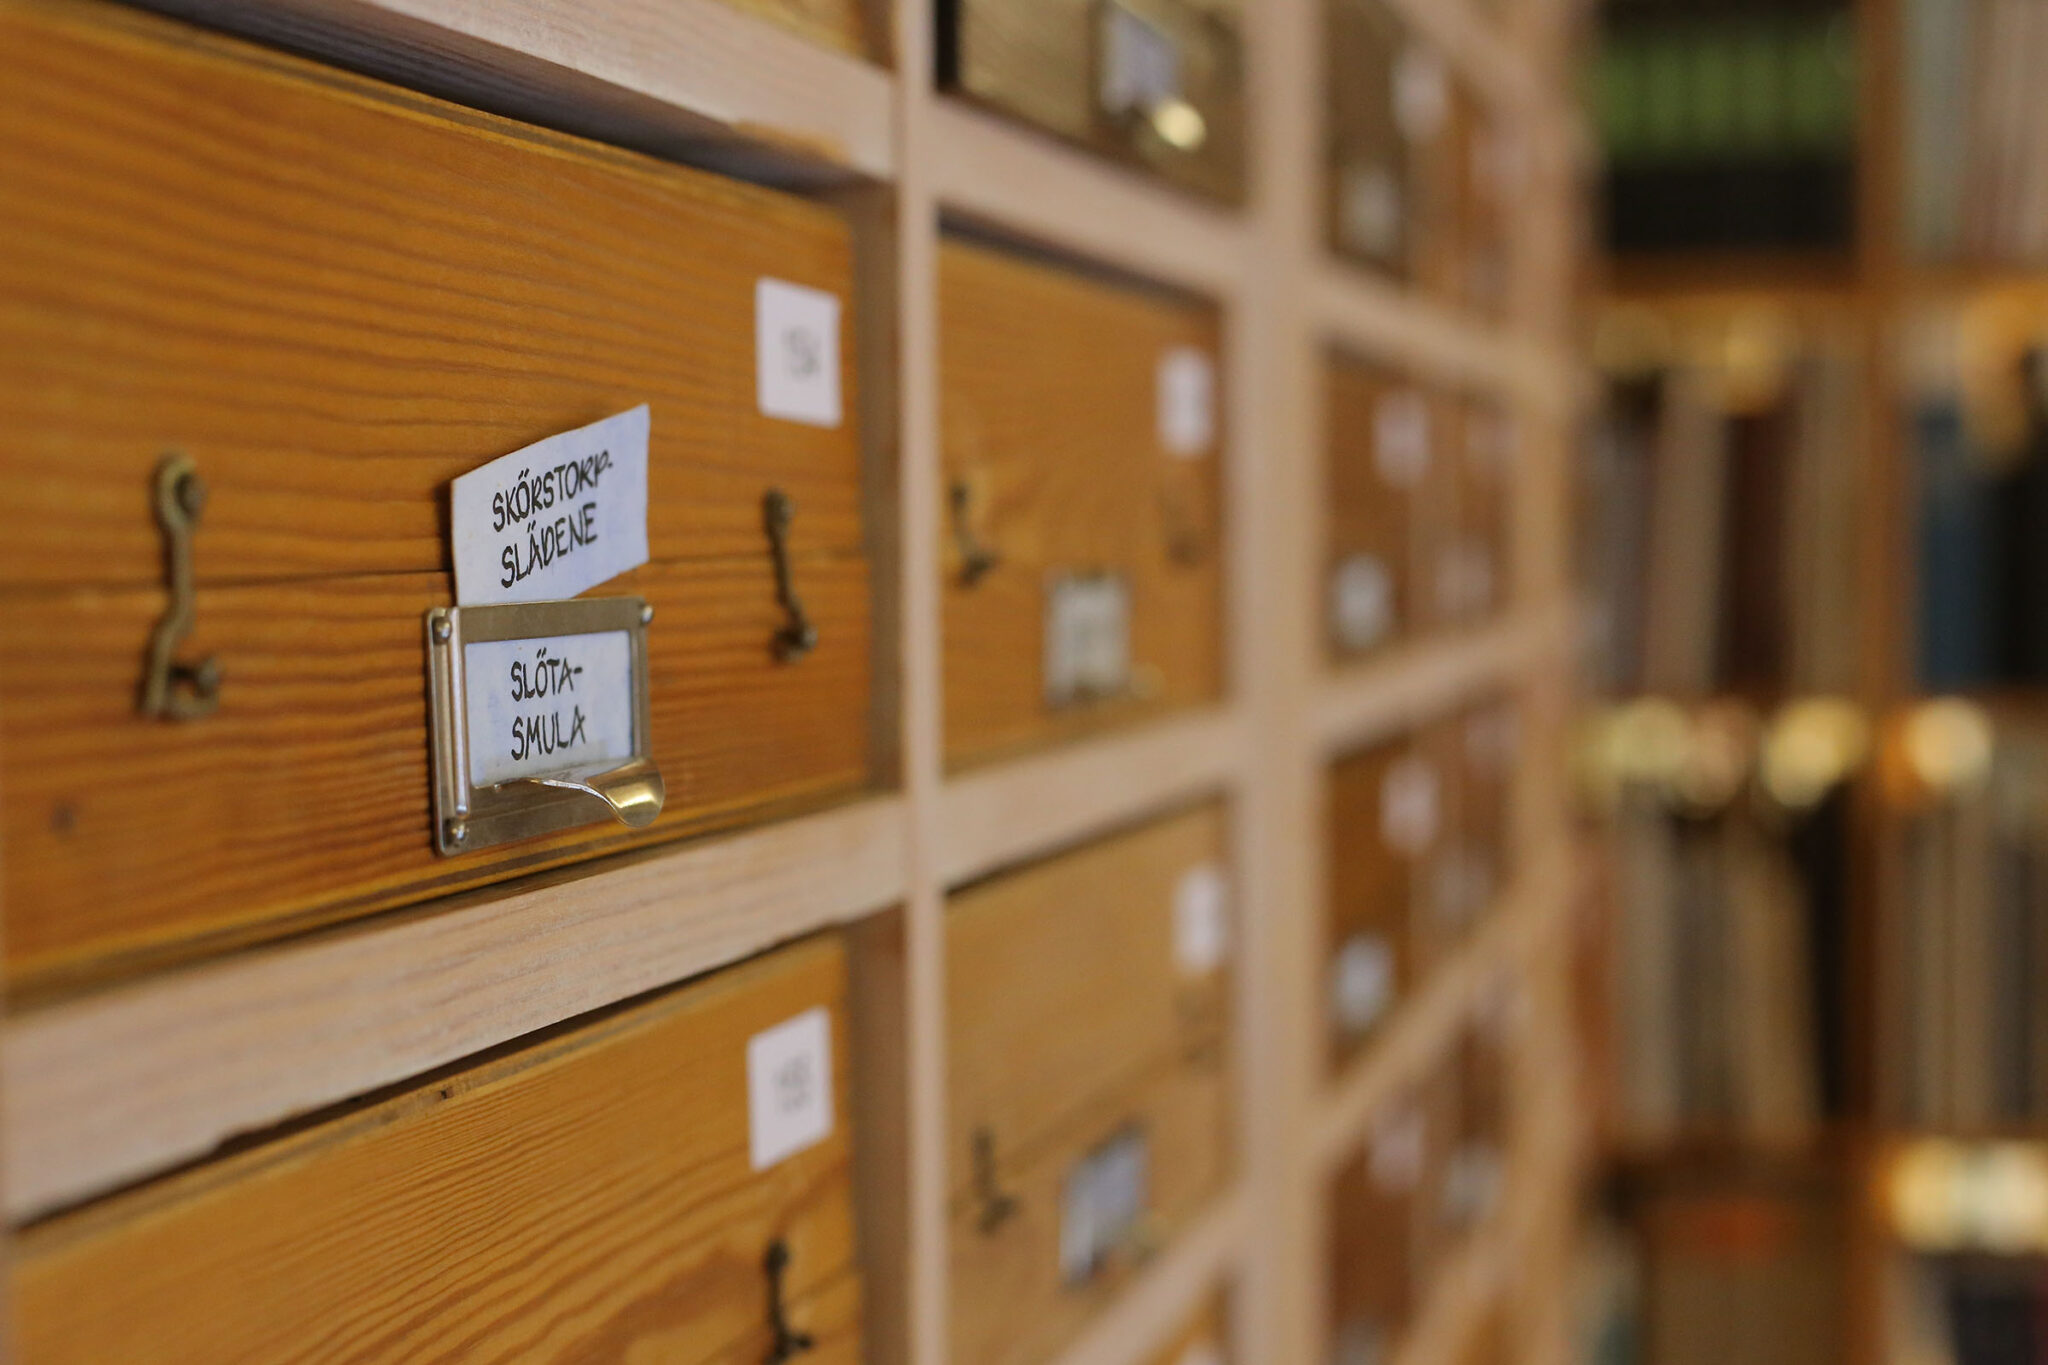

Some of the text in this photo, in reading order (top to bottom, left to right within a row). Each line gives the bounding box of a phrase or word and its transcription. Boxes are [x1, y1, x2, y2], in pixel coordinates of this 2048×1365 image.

[500, 502, 598, 589] SLÄDENE
[510, 647, 583, 702] SLÖTA-
[511, 705, 586, 761] SMULA
